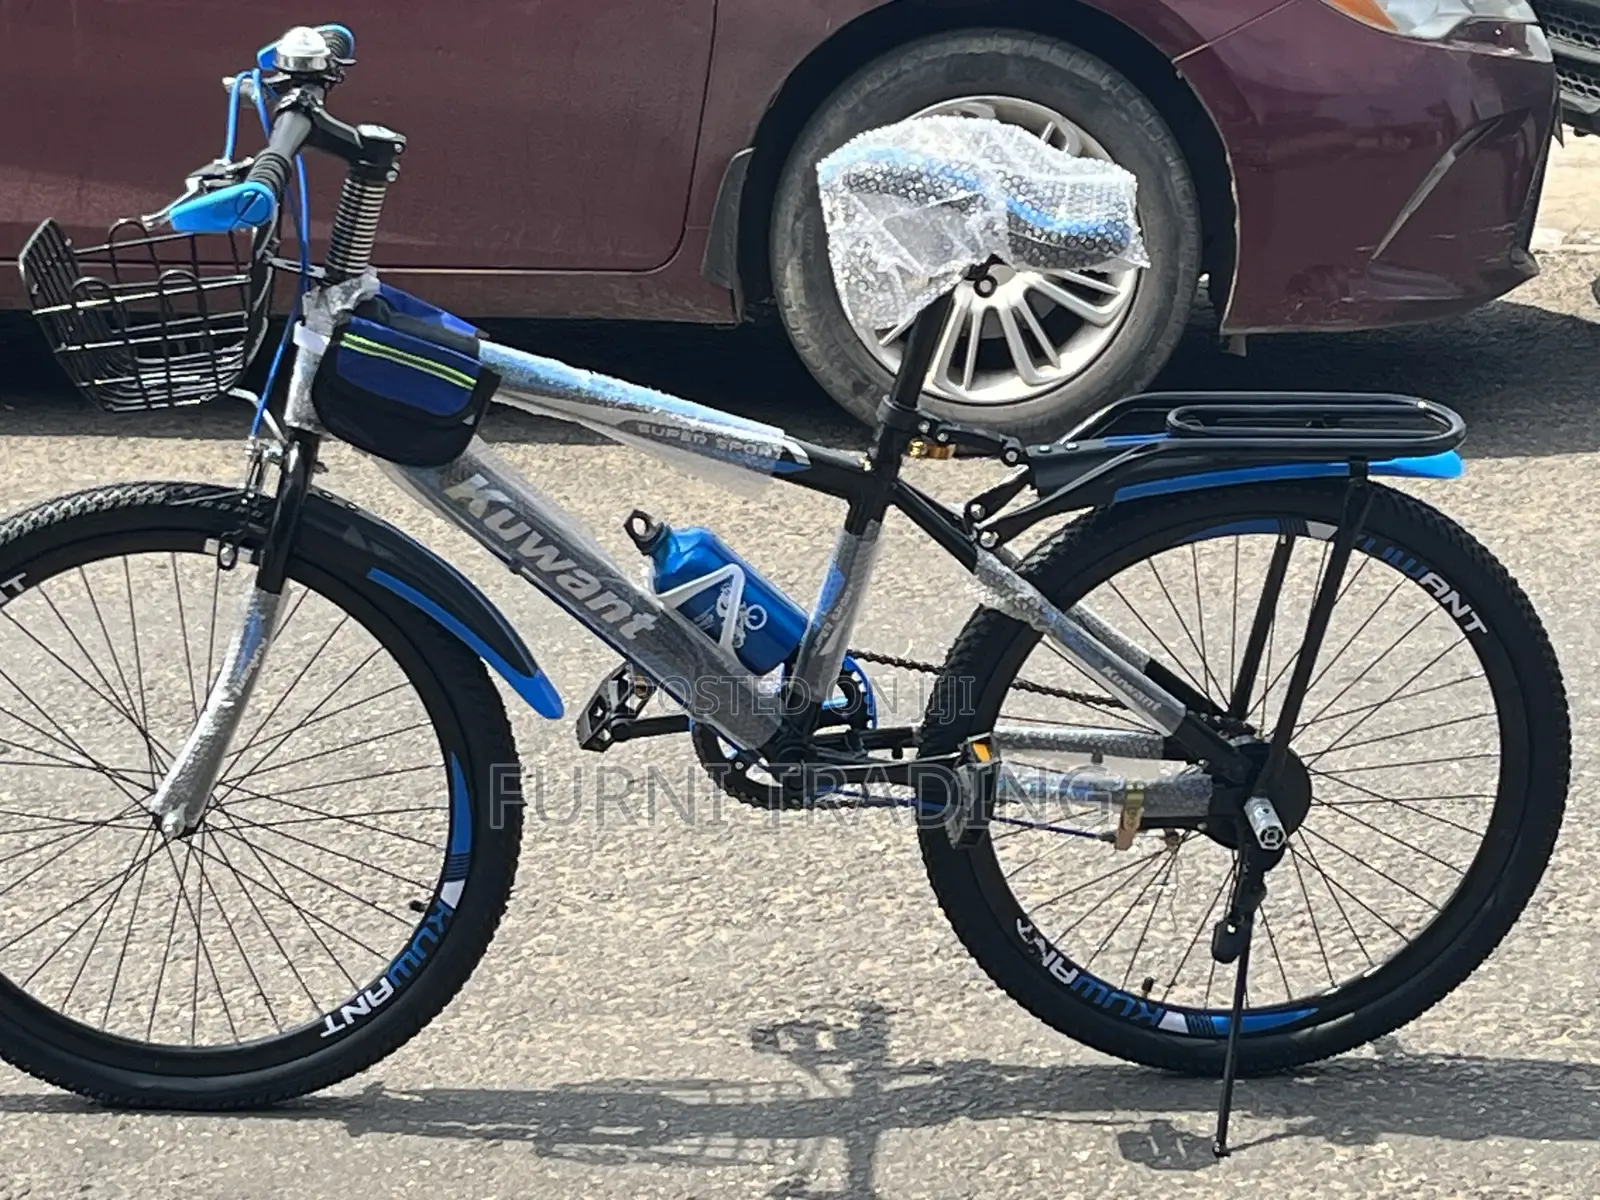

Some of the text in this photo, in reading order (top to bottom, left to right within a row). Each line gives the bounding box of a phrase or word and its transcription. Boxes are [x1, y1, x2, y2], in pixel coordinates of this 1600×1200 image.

[638, 423, 784, 462] SUPER SPORT
[443, 473, 658, 640] Kuwant
[320, 899, 454, 1038] KUWANT
